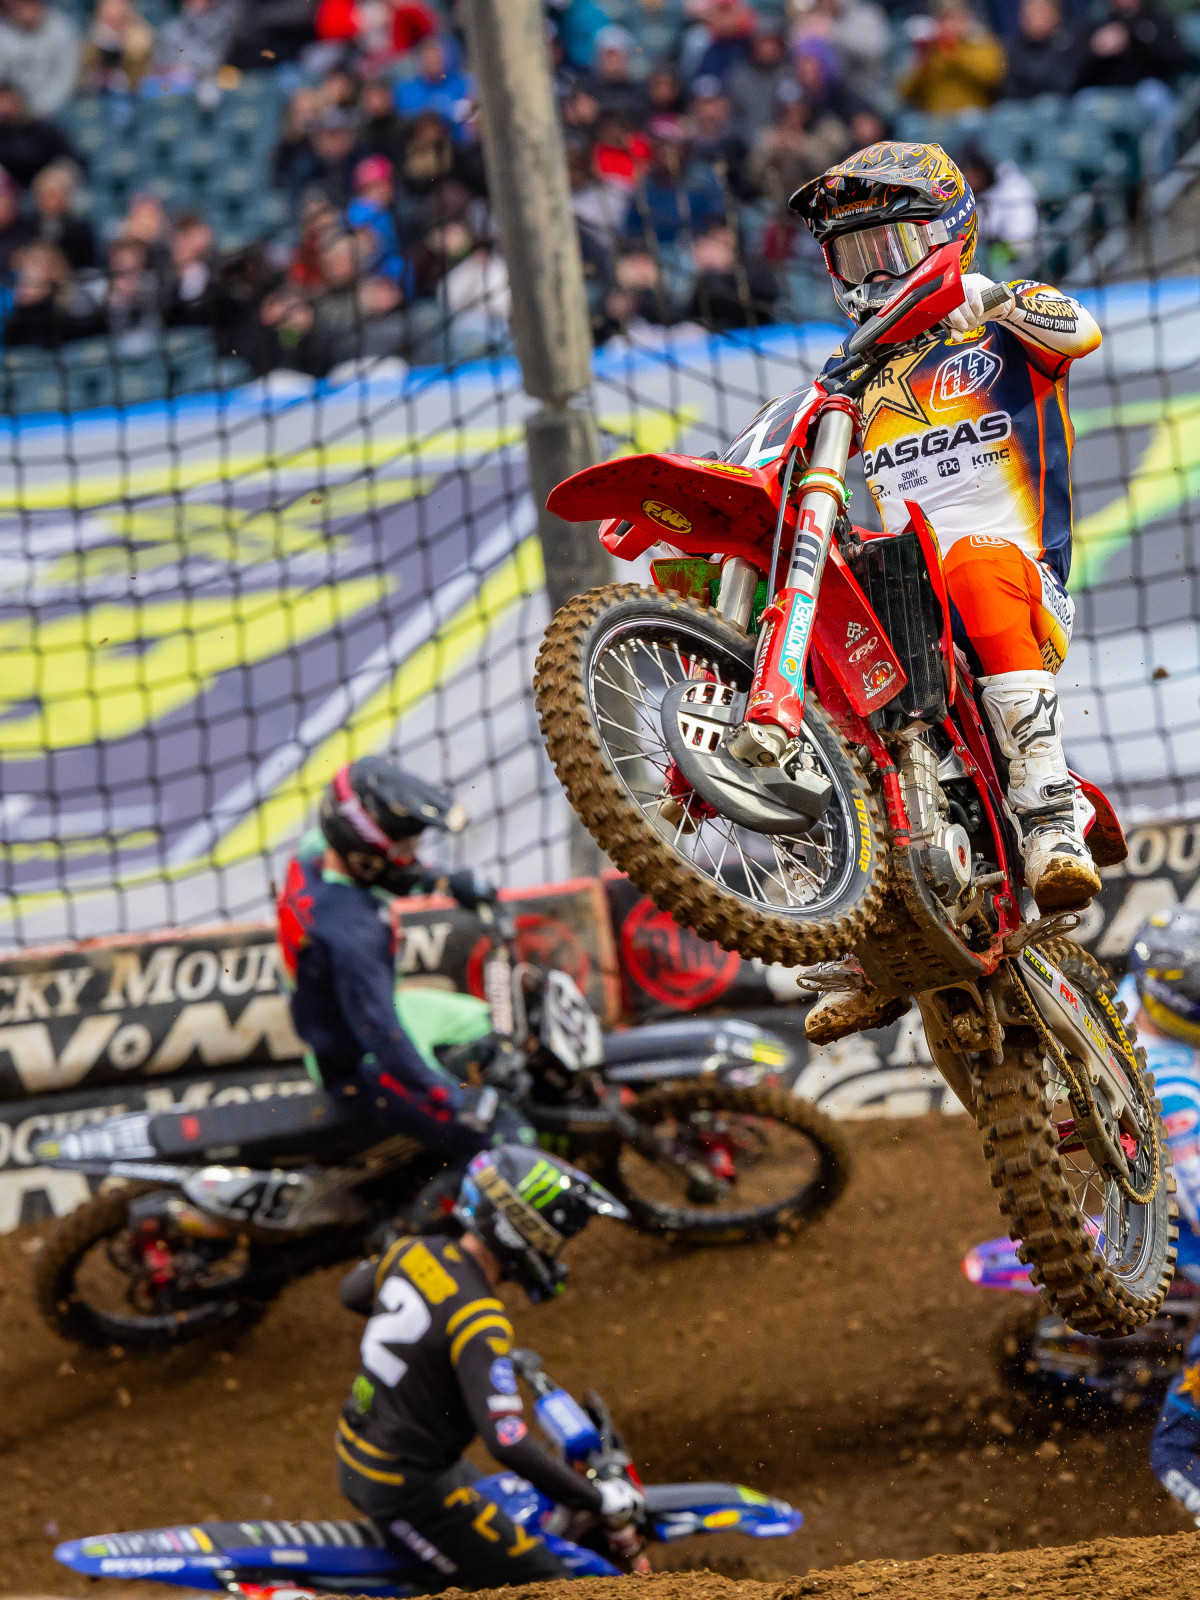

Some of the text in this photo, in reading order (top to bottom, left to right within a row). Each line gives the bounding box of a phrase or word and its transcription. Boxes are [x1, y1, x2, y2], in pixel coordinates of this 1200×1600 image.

[831, 198, 878, 216] ROCKSTAR
[835, 206, 873, 219] ENERGY DRINK
[1026, 312, 1076, 331] ENERGY DRINK
[863, 414, 1010, 478] GASGAS
[901, 468, 919, 482] SONY
[938, 461, 960, 476] PPG
[898, 475, 928, 493] PICTURES
[643, 502, 693, 529] FMF
[785, 600, 813, 660] MOTOREX
[854, 797, 873, 873] DUNLOP
[1024, 949, 1053, 981] EXCEL
[0, 966, 95, 1022] CKY
[360, 1276, 432, 1388] 2
[443, 1485, 544, 1558] FLY
